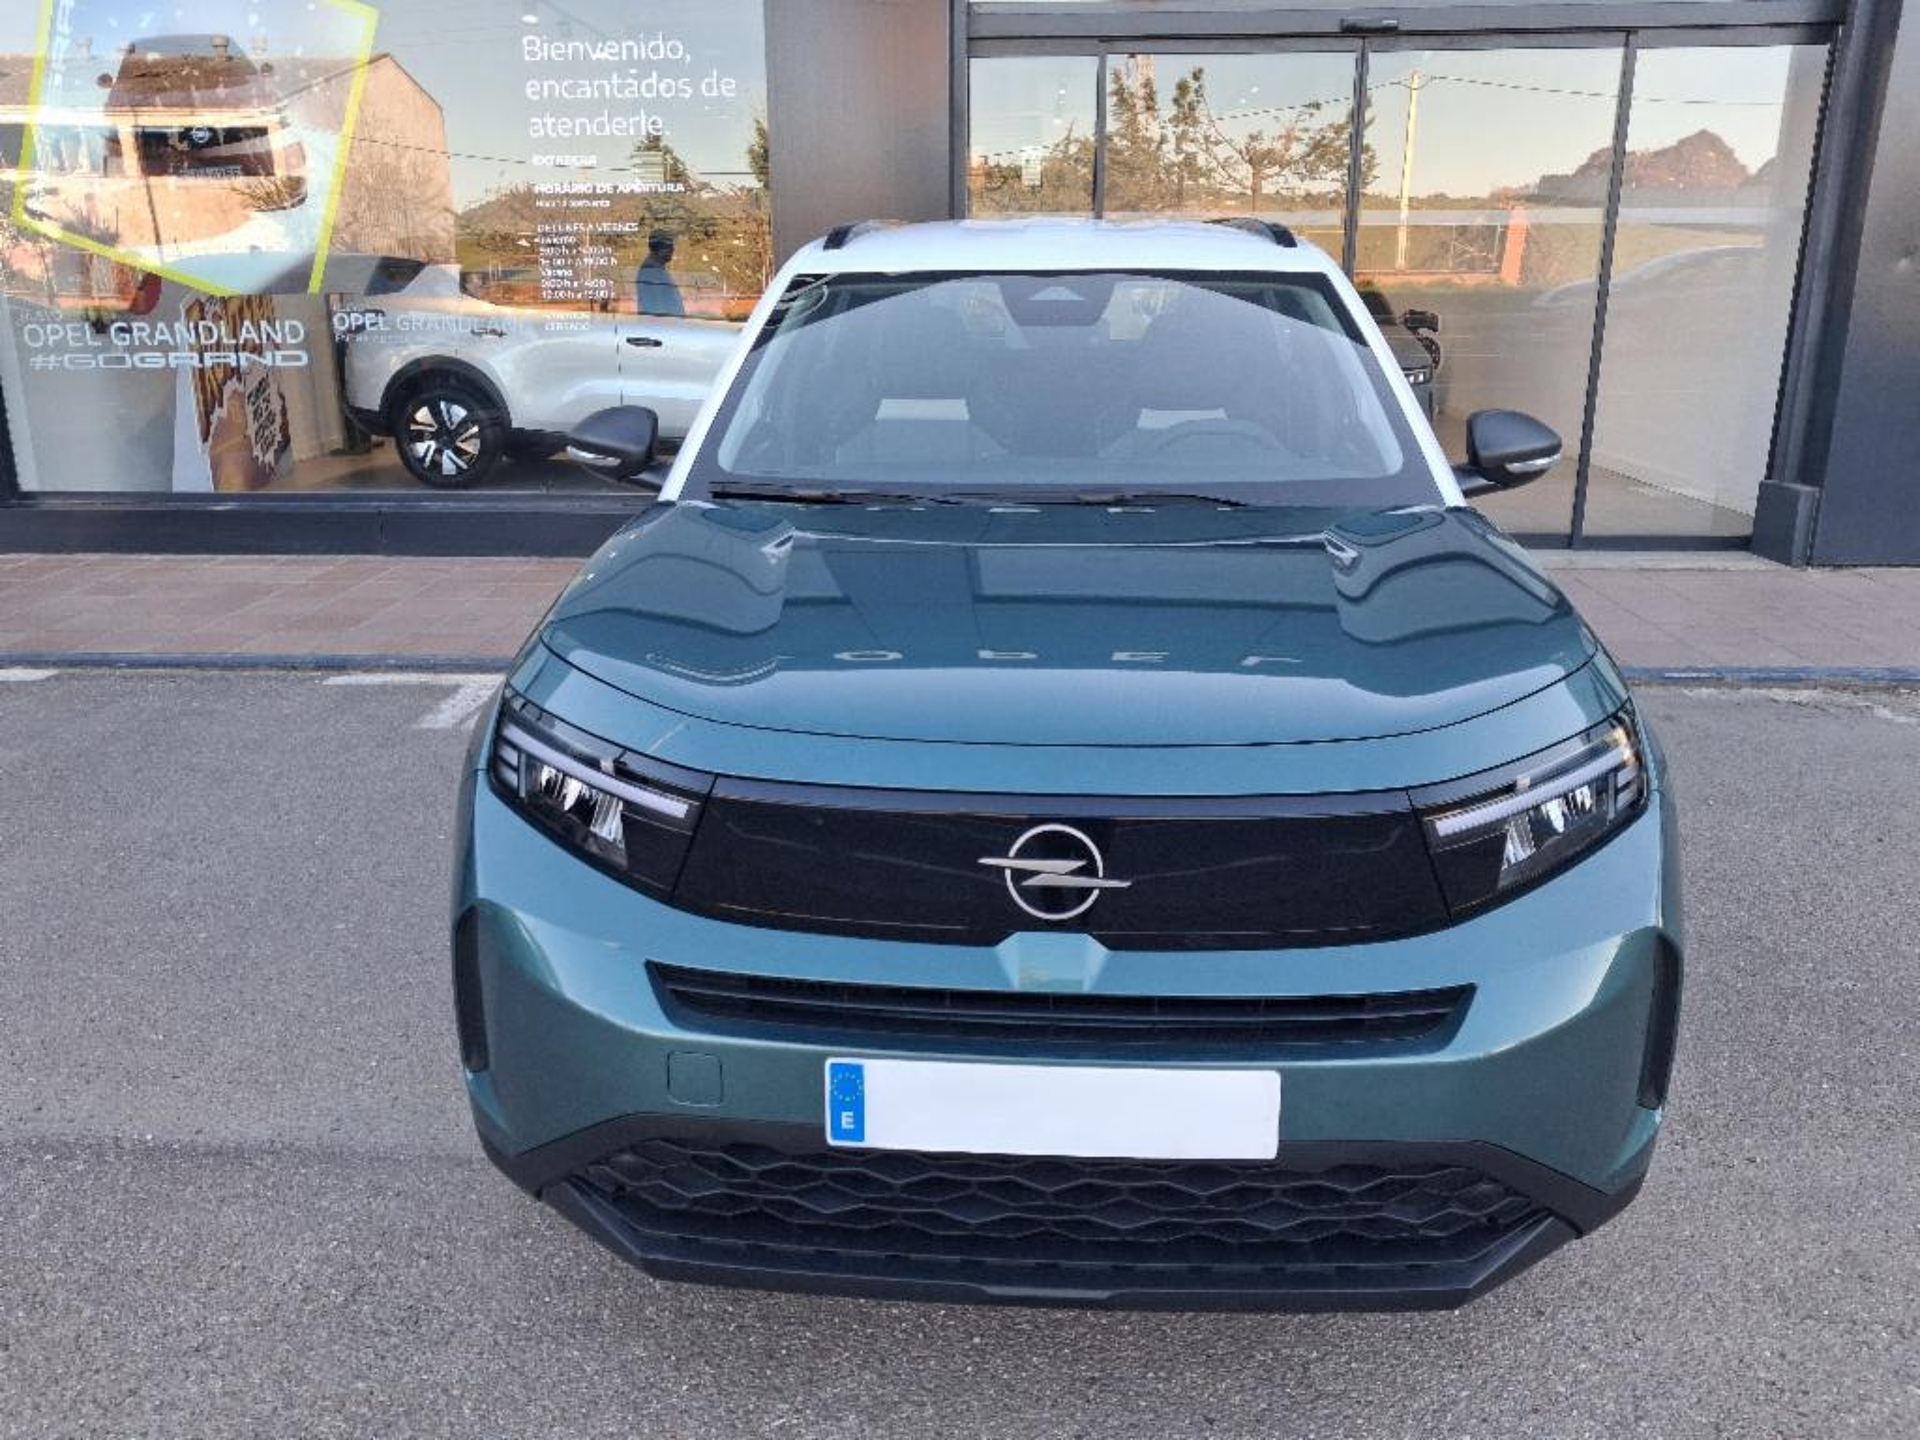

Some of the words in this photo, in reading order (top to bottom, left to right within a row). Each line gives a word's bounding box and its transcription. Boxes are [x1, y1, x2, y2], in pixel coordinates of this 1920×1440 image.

[523, 32, 692, 63] Bienvenido,
[525, 70, 692, 99] encantados
[701, 69, 737, 97] de
[528, 109, 671, 137] atenderle.
[534, 183, 594, 194] HORARIO
[596, 183, 615, 193] DE
[616, 182, 686, 193] APERTURA
[24, 323, 102, 347] OPEL
[110, 320, 306, 346] GRANDLAND
[332, 312, 391, 332] OPEL
[29, 351, 309, 370] #GOGRAND
[840, 1111, 855, 1129] E
